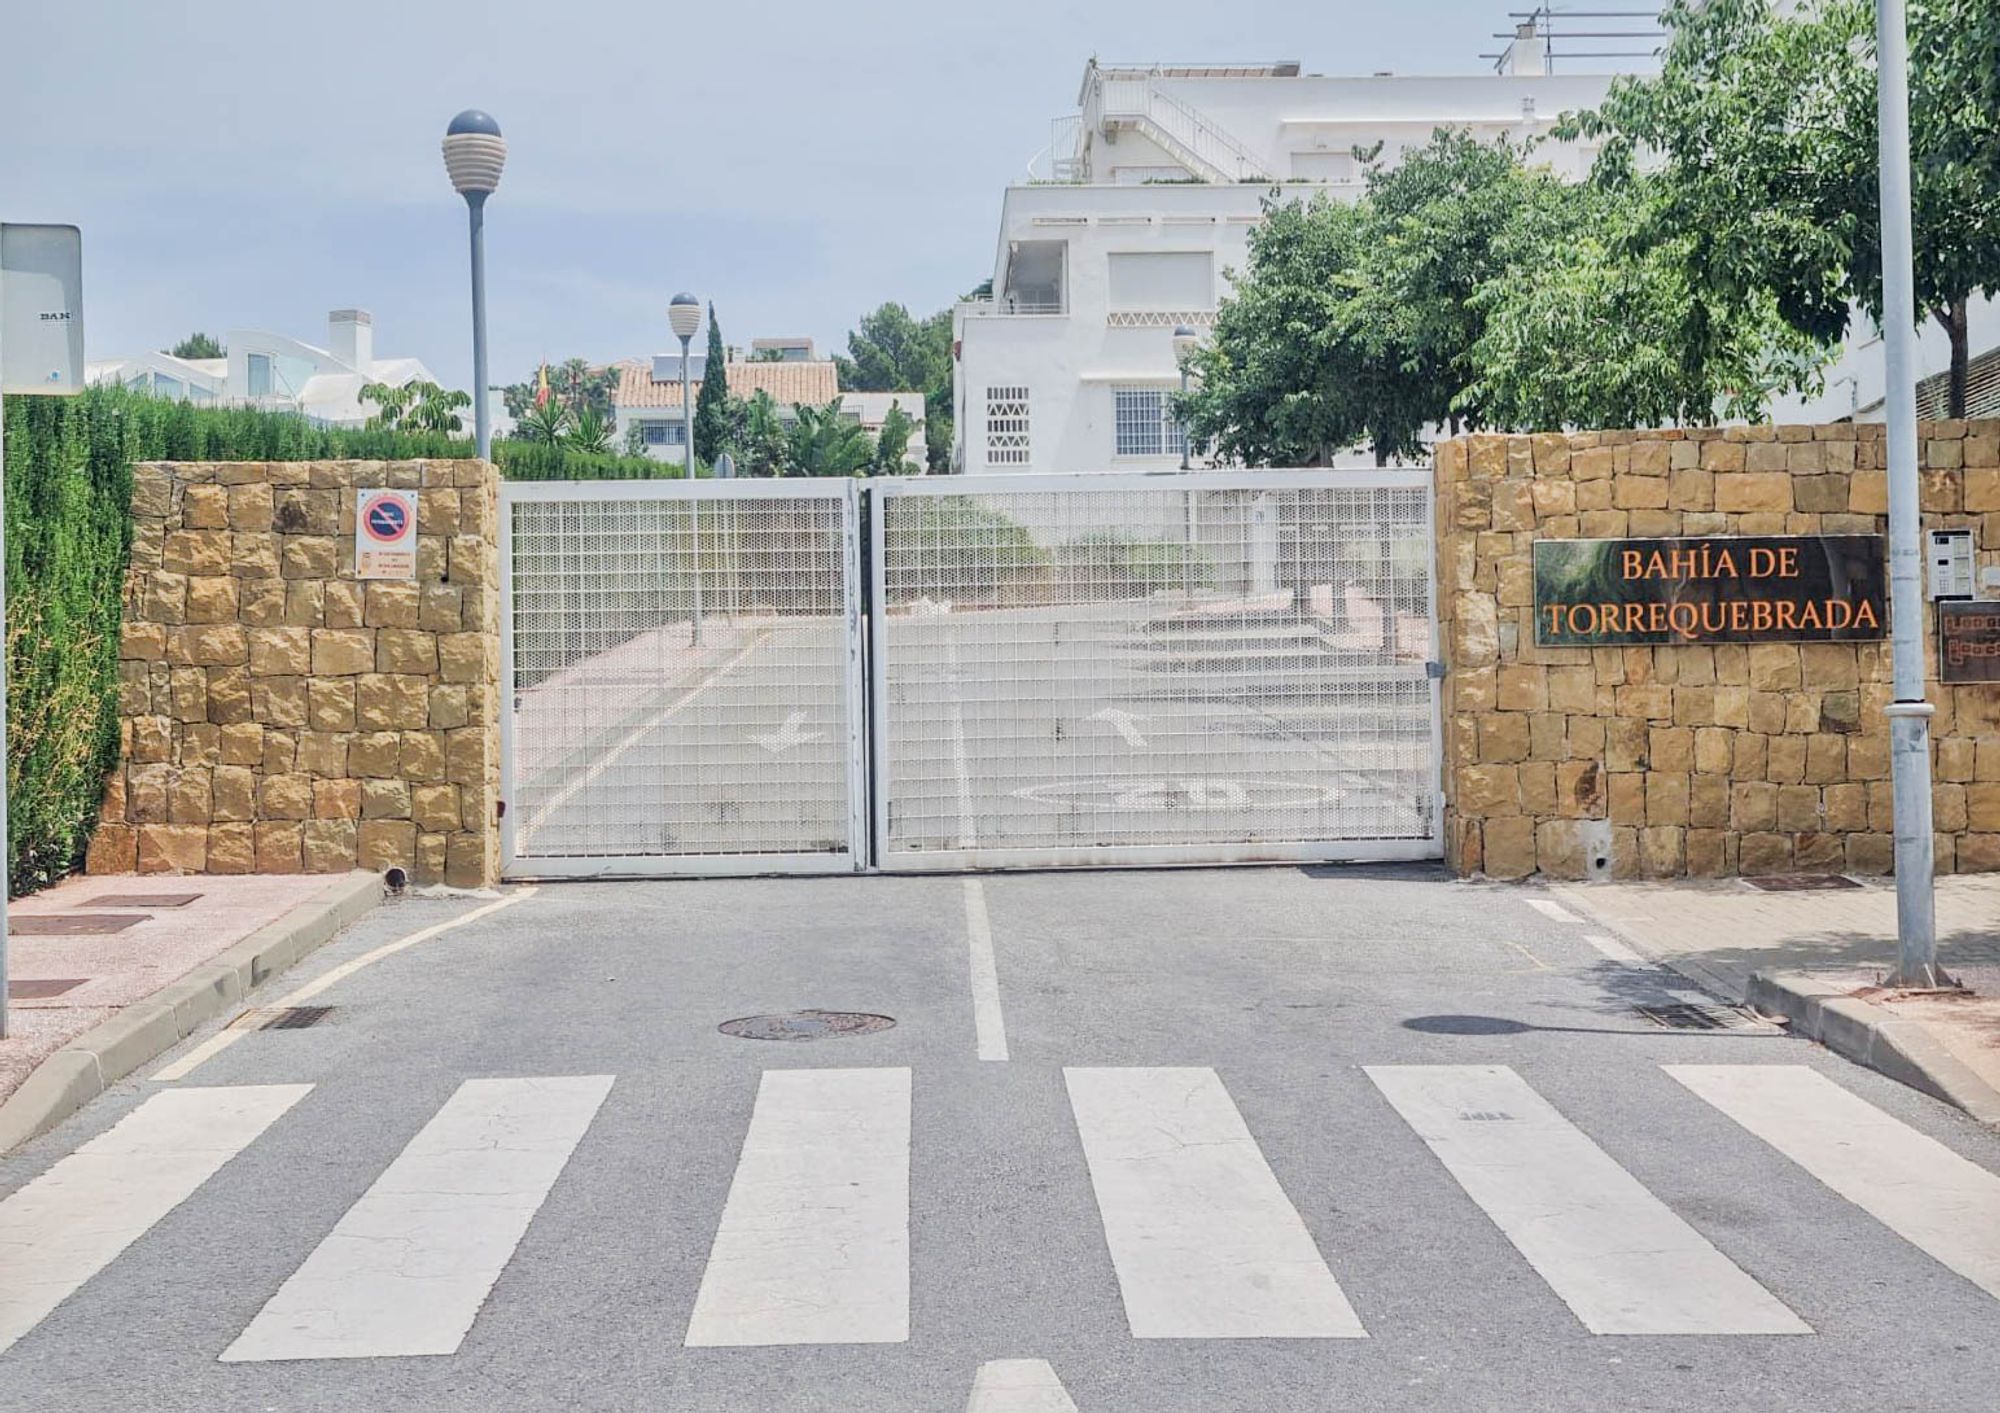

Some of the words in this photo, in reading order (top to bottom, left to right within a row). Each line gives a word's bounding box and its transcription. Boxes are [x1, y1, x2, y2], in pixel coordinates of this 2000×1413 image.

[1622, 544, 1738, 580] BAHÍA
[1750, 547, 1799, 578] DE
[1542, 599, 1879, 639] TORREQUEBRADA
